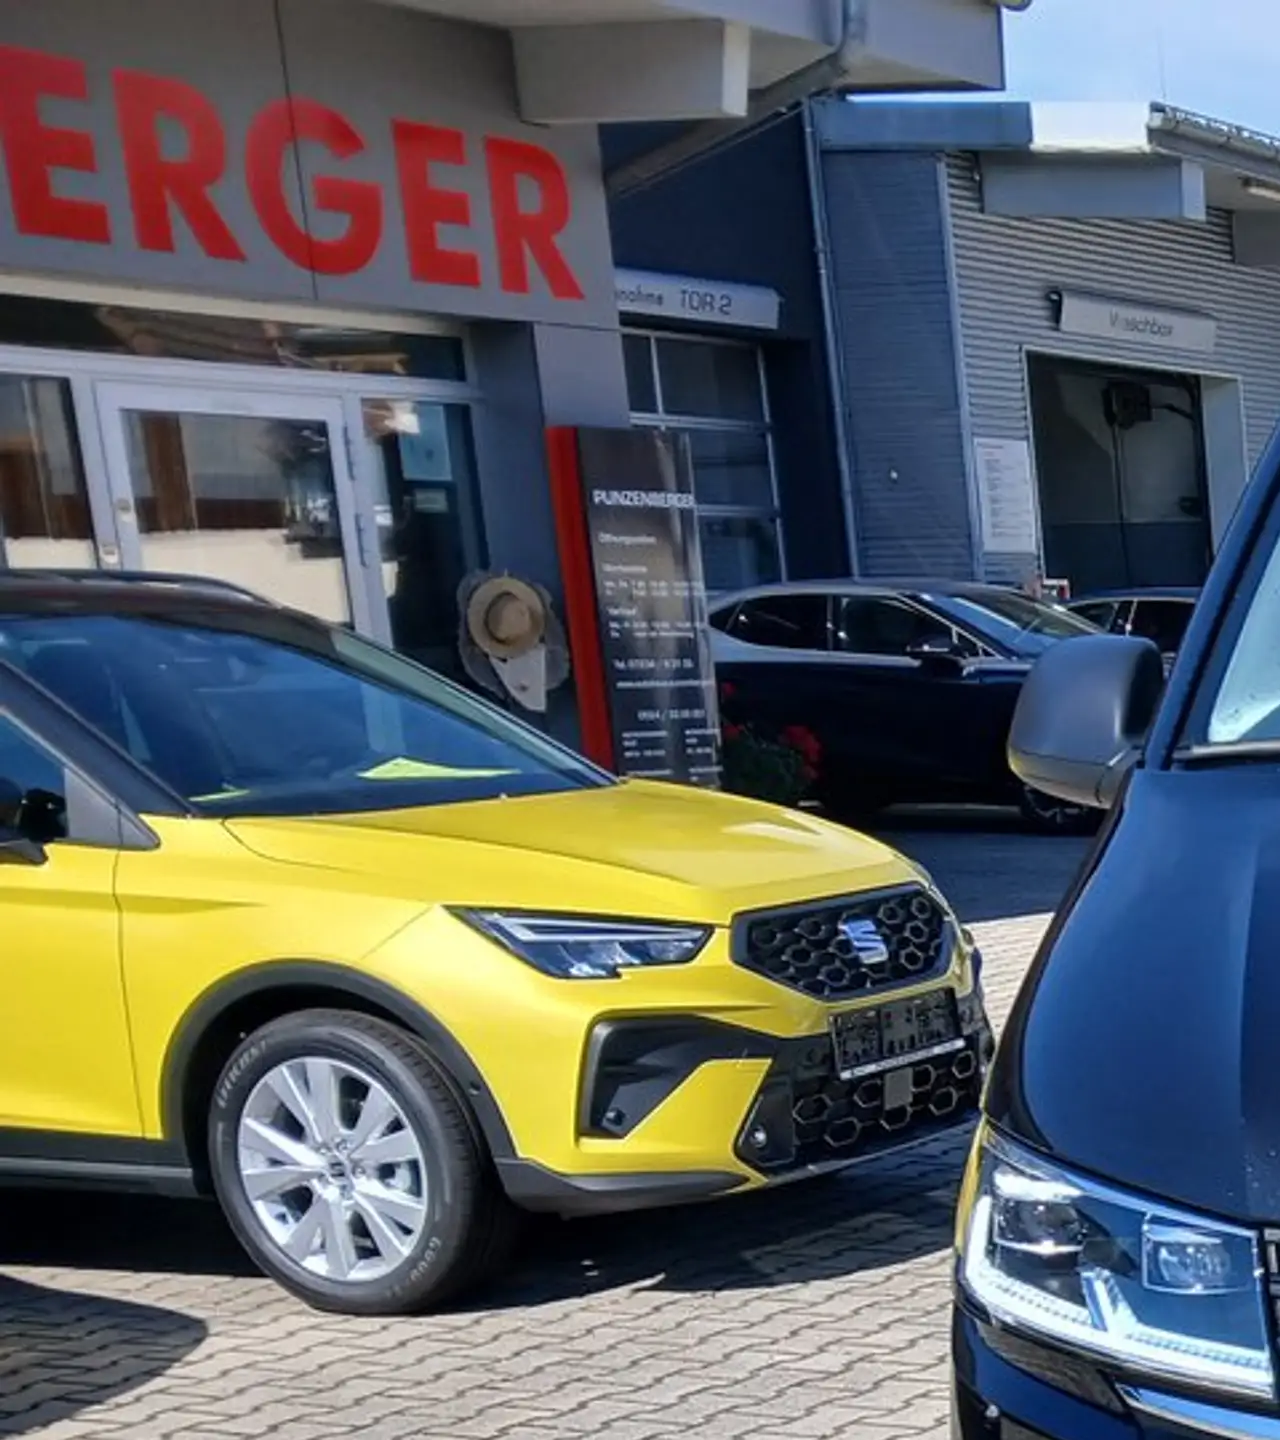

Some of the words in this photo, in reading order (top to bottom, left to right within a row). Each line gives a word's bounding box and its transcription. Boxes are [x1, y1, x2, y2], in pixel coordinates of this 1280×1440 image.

[0, 44, 585, 301] ERGER
[680, 289, 715, 313] TOR
[718, 294, 733, 315] 2
